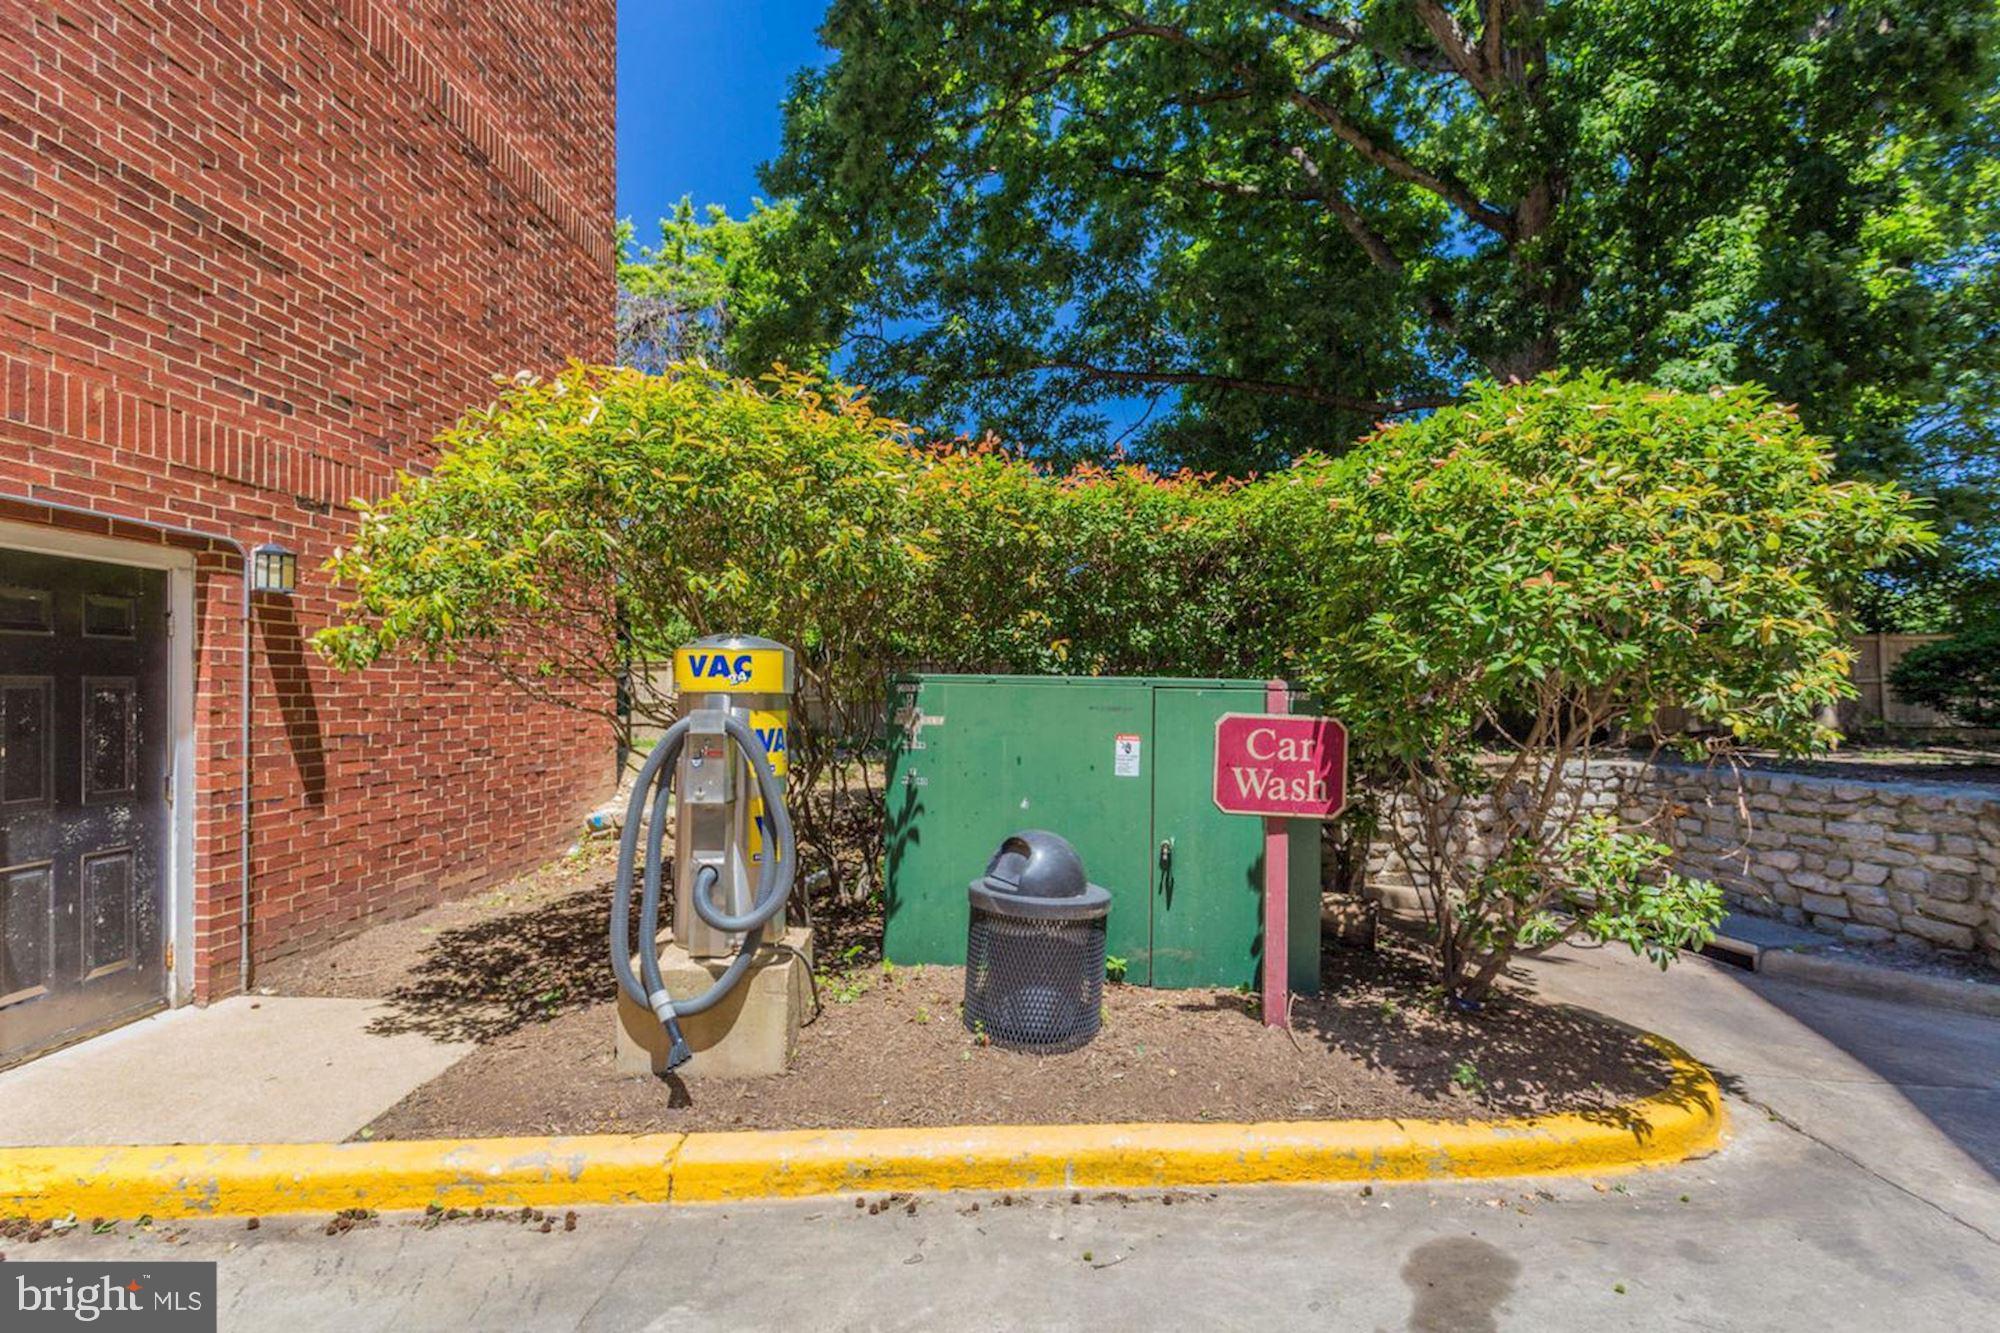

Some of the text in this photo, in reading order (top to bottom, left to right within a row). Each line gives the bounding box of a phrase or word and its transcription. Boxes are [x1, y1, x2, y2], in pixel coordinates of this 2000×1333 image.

[688, 655, 752, 678] VAC
[1246, 728, 1316, 762] Car
[1231, 767, 1328, 802] Wash
